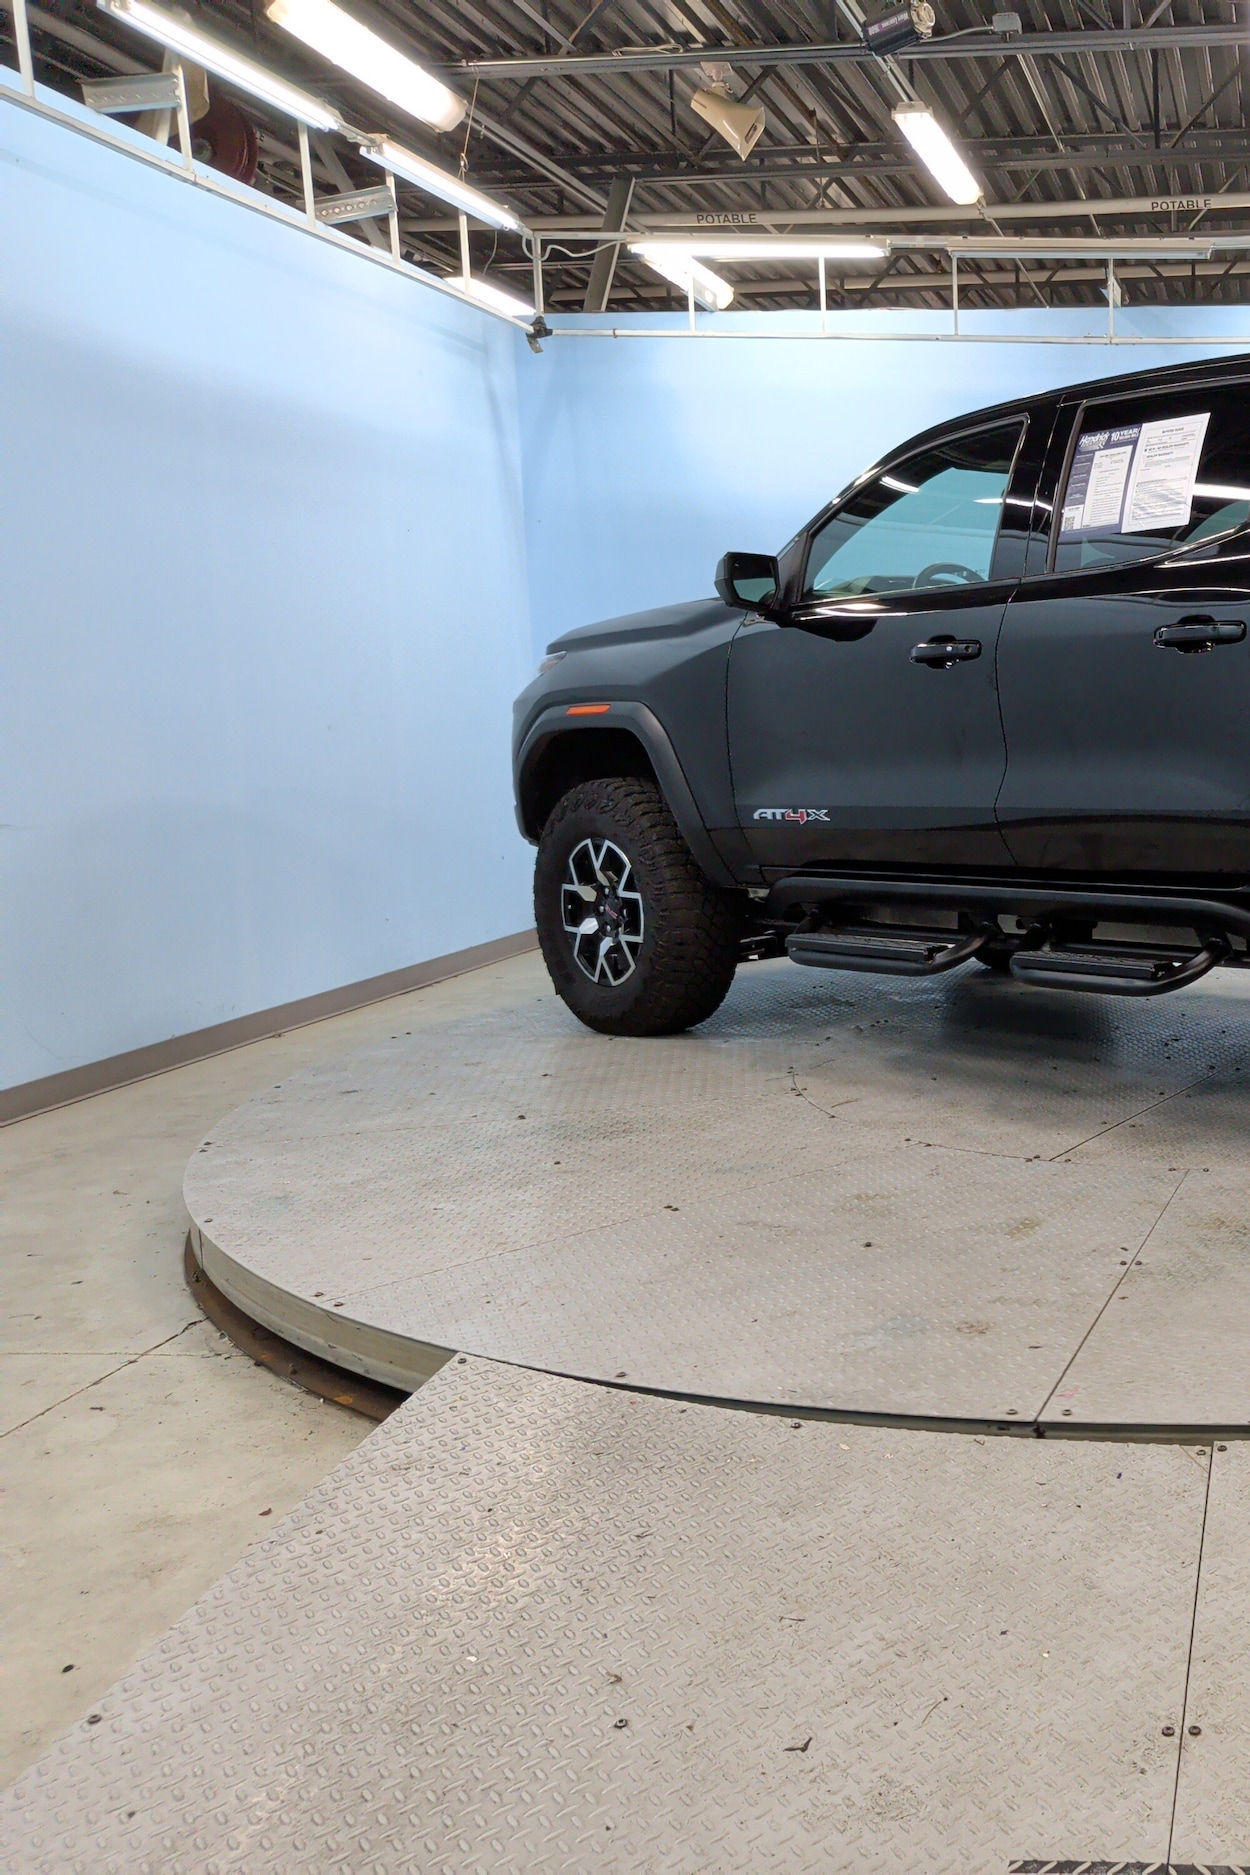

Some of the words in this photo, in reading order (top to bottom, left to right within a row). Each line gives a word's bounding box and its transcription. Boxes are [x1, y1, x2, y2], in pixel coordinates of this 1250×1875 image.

[1151, 198, 1212, 211] POTABLE
[696, 213, 758, 225] POTABLE
[753, 807, 831, 825] AT4X
